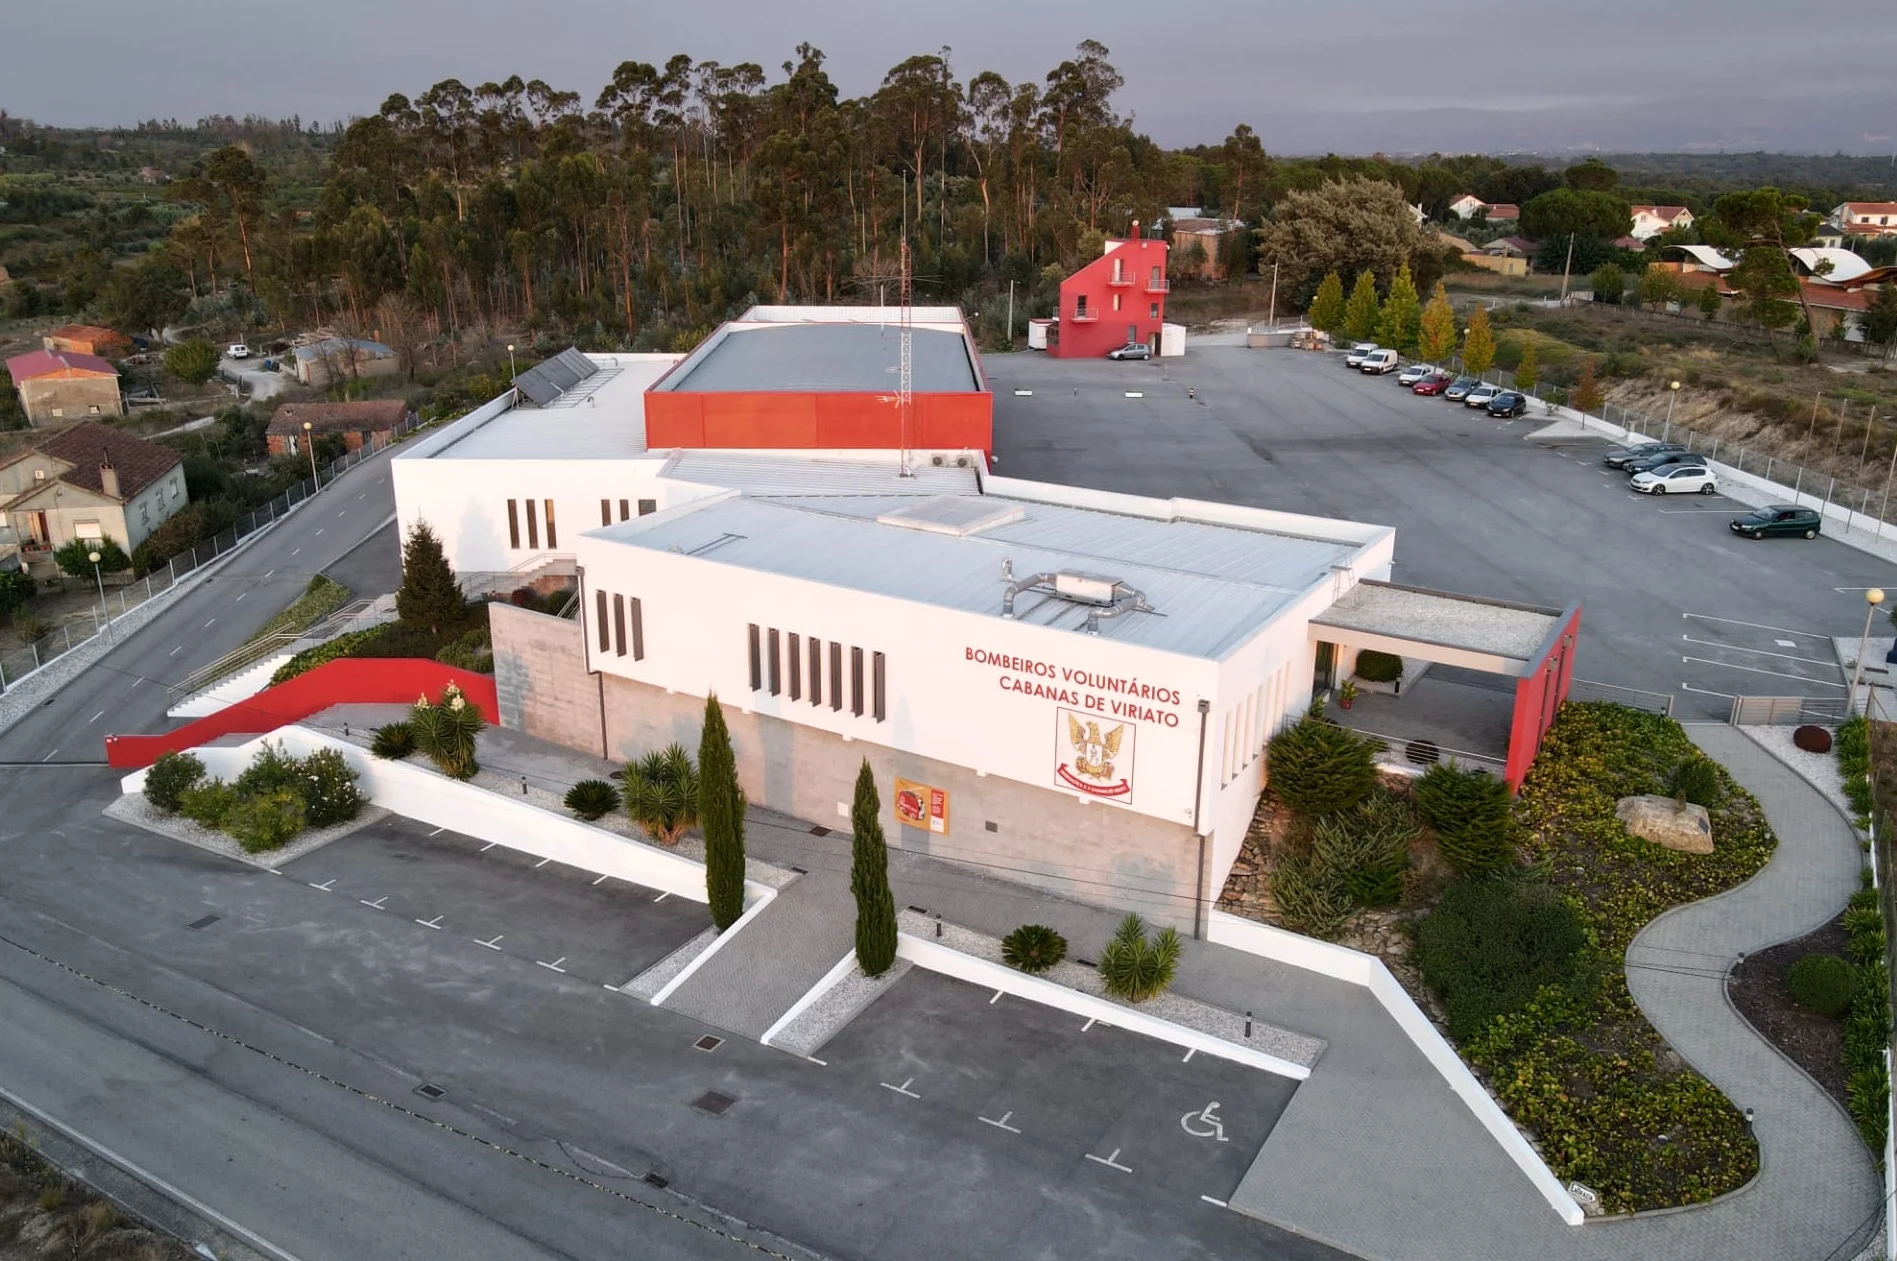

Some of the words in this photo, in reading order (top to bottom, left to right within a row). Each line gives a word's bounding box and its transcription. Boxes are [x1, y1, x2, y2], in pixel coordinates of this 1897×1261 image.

[965, 647, 1056, 679] BOMBEIROS
[1062, 667, 1181, 705] VOLUNTÁRIOS
[1000, 676, 1079, 705] CABANAS
[1085, 695, 1105, 711] DE
[1111, 700, 1179, 728] VIRIATO
